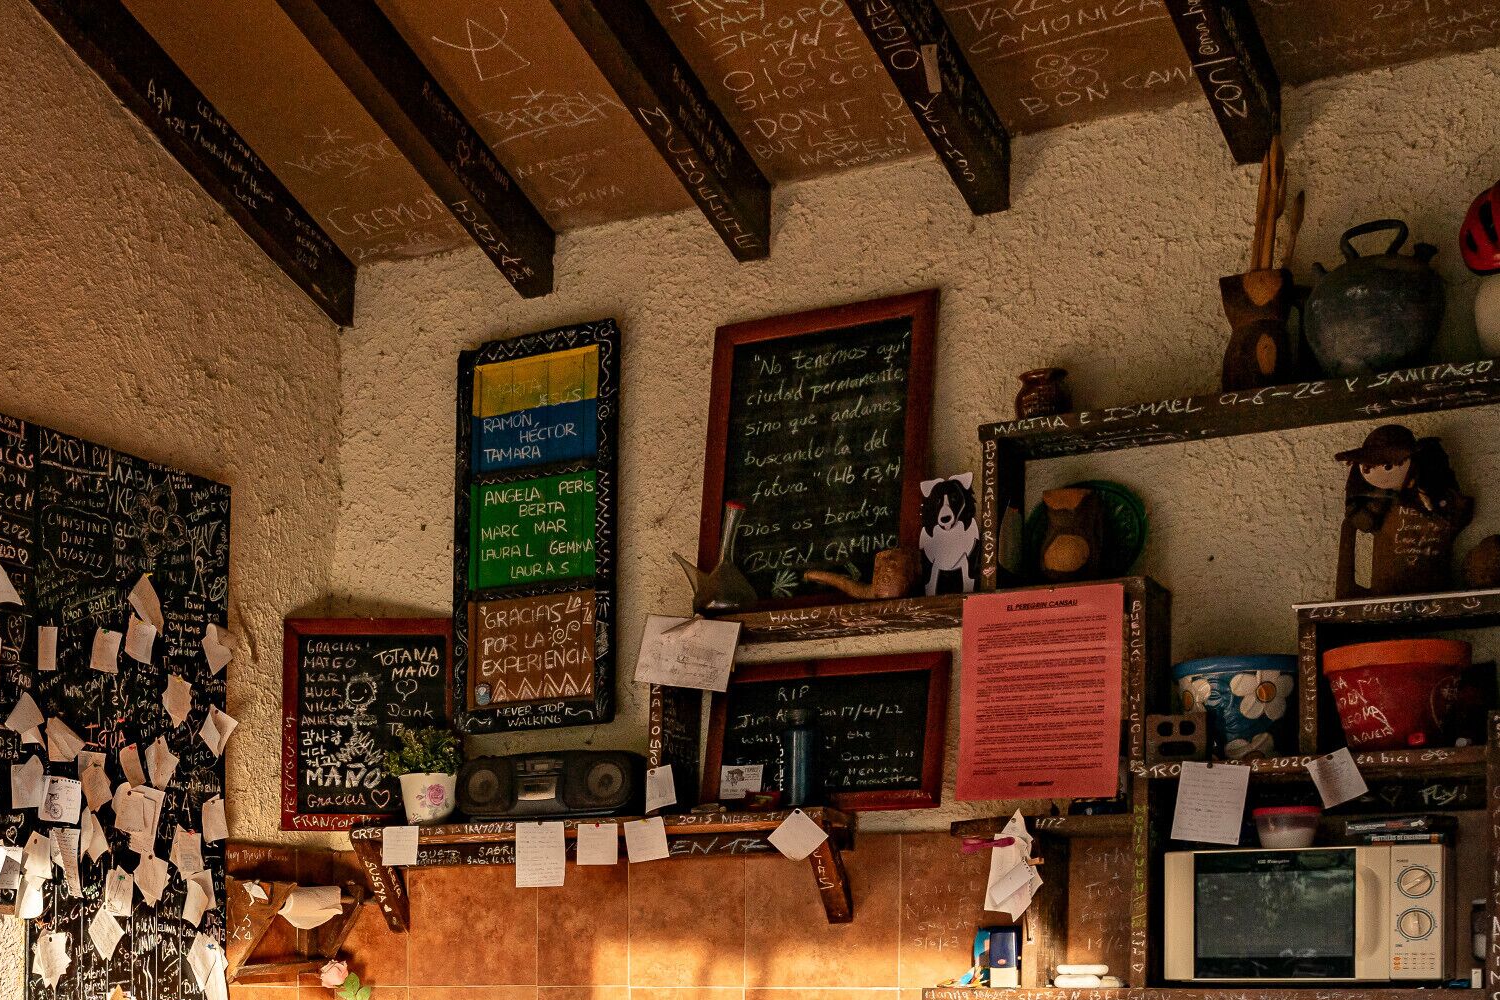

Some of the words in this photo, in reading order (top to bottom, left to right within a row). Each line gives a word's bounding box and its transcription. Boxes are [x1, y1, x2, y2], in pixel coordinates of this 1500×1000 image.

[1020, 82, 1108, 116] BON
[792, 346, 867, 370] tenemos
[877, 331, 910, 362] aquí
[747, 382, 804, 406] ciudad
[484, 410, 532, 434] RAMÓN
[745, 420, 781, 436] sino
[790, 413, 817, 435] que
[832, 396, 902, 423] andamos
[994, 414, 1065, 434] MARTHA
[1103, 397, 1202, 423] ISMAEL
[520, 421, 577, 443] HÉCTOR
[484, 446, 541, 462] TAMARA
[745, 438, 822, 467] buscando
[834, 436, 851, 453] la
[869, 429, 889, 450] del
[484, 486, 540, 507] ANGELA
[519, 502, 565, 517] BERTA
[482, 524, 520, 541] MARC
[535, 519, 567, 535] MAR
[740, 521, 780, 537] Dios
[792, 519, 813, 531] os
[482, 544, 521, 560] LAURA
[550, 539, 593, 555] GEMMA
[744, 543, 813, 573] BUEN
[511, 563, 555, 579] LAURA
[482, 635, 517, 656] POR
[523, 631, 545, 648] LA
[303, 656, 356, 669] MATEO
[778, 686, 810, 701] RIP
[497, 704, 534, 718] NEVER
[539, 702, 564, 715] STOP
[508, 714, 560, 727] WALKING
